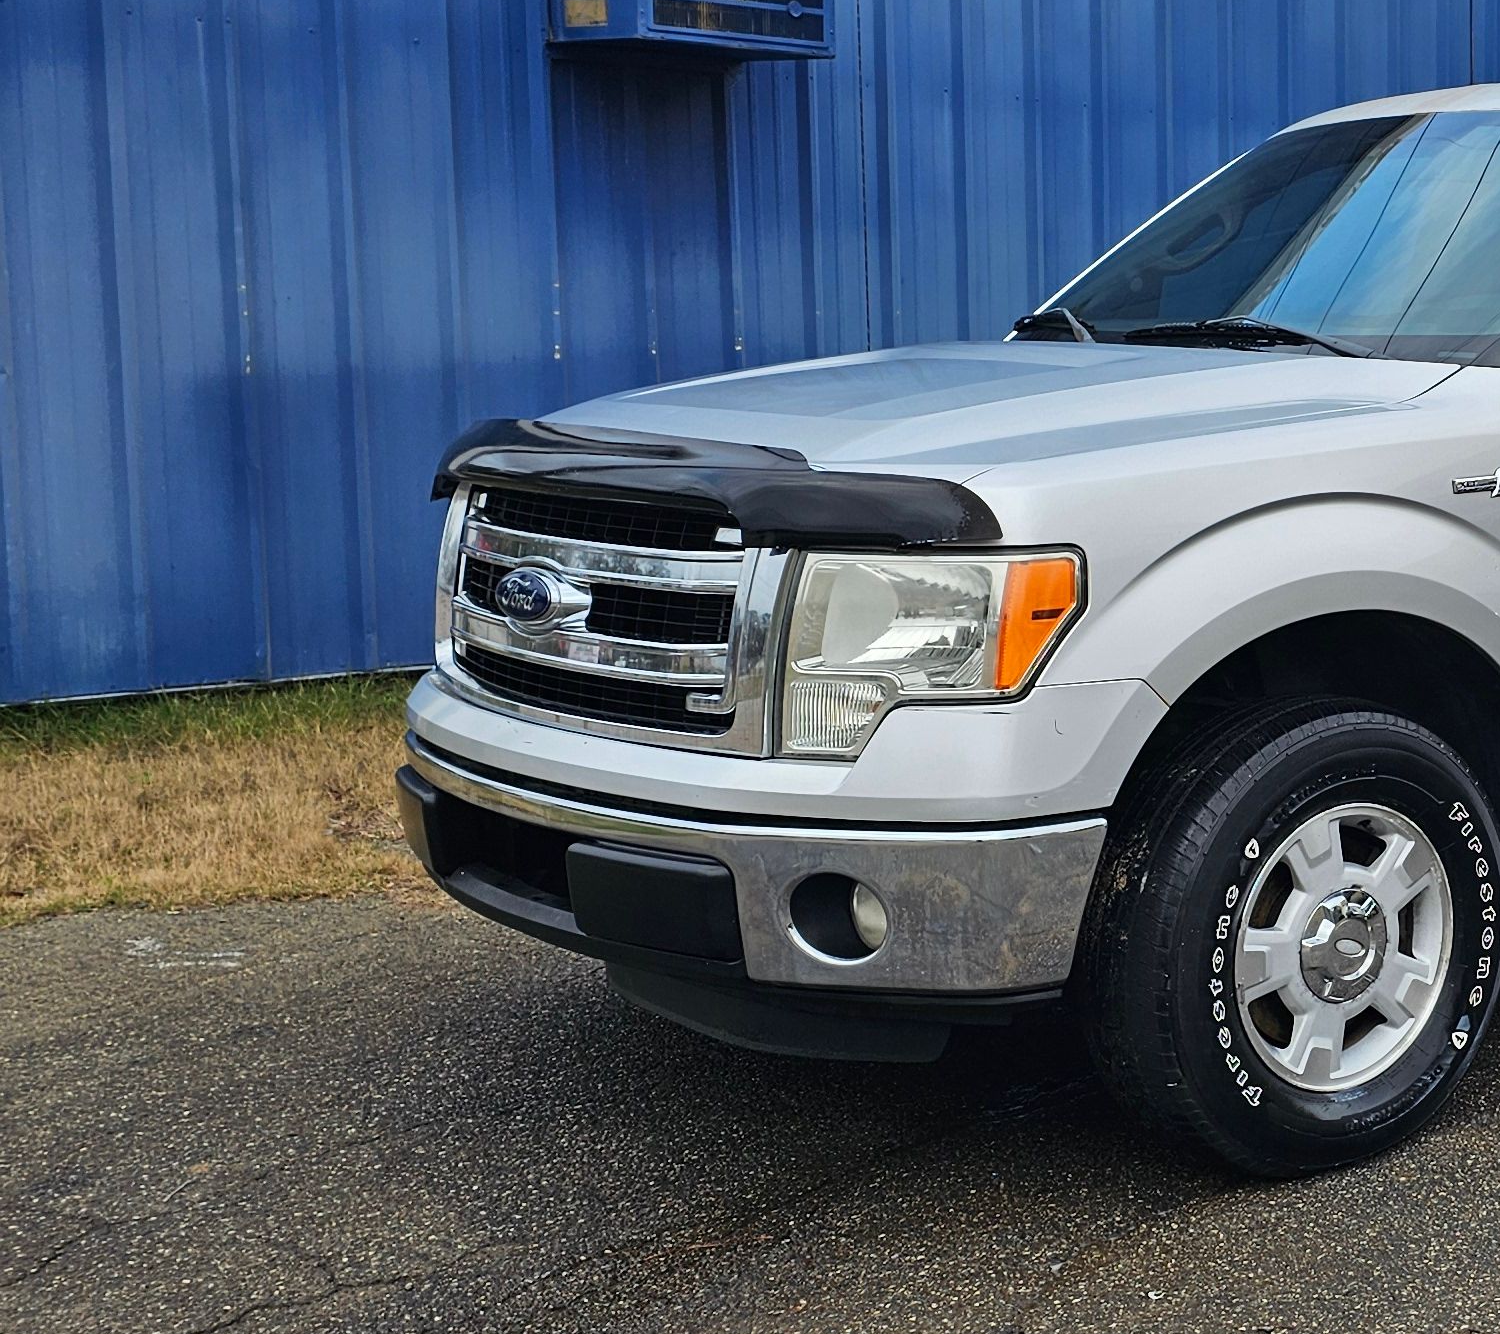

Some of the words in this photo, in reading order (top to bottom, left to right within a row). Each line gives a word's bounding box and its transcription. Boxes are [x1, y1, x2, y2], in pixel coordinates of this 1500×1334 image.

[501, 577, 538, 611] Ford
[1208, 884, 1263, 1107] Firestone
[1449, 801, 1497, 1007] Firestone
